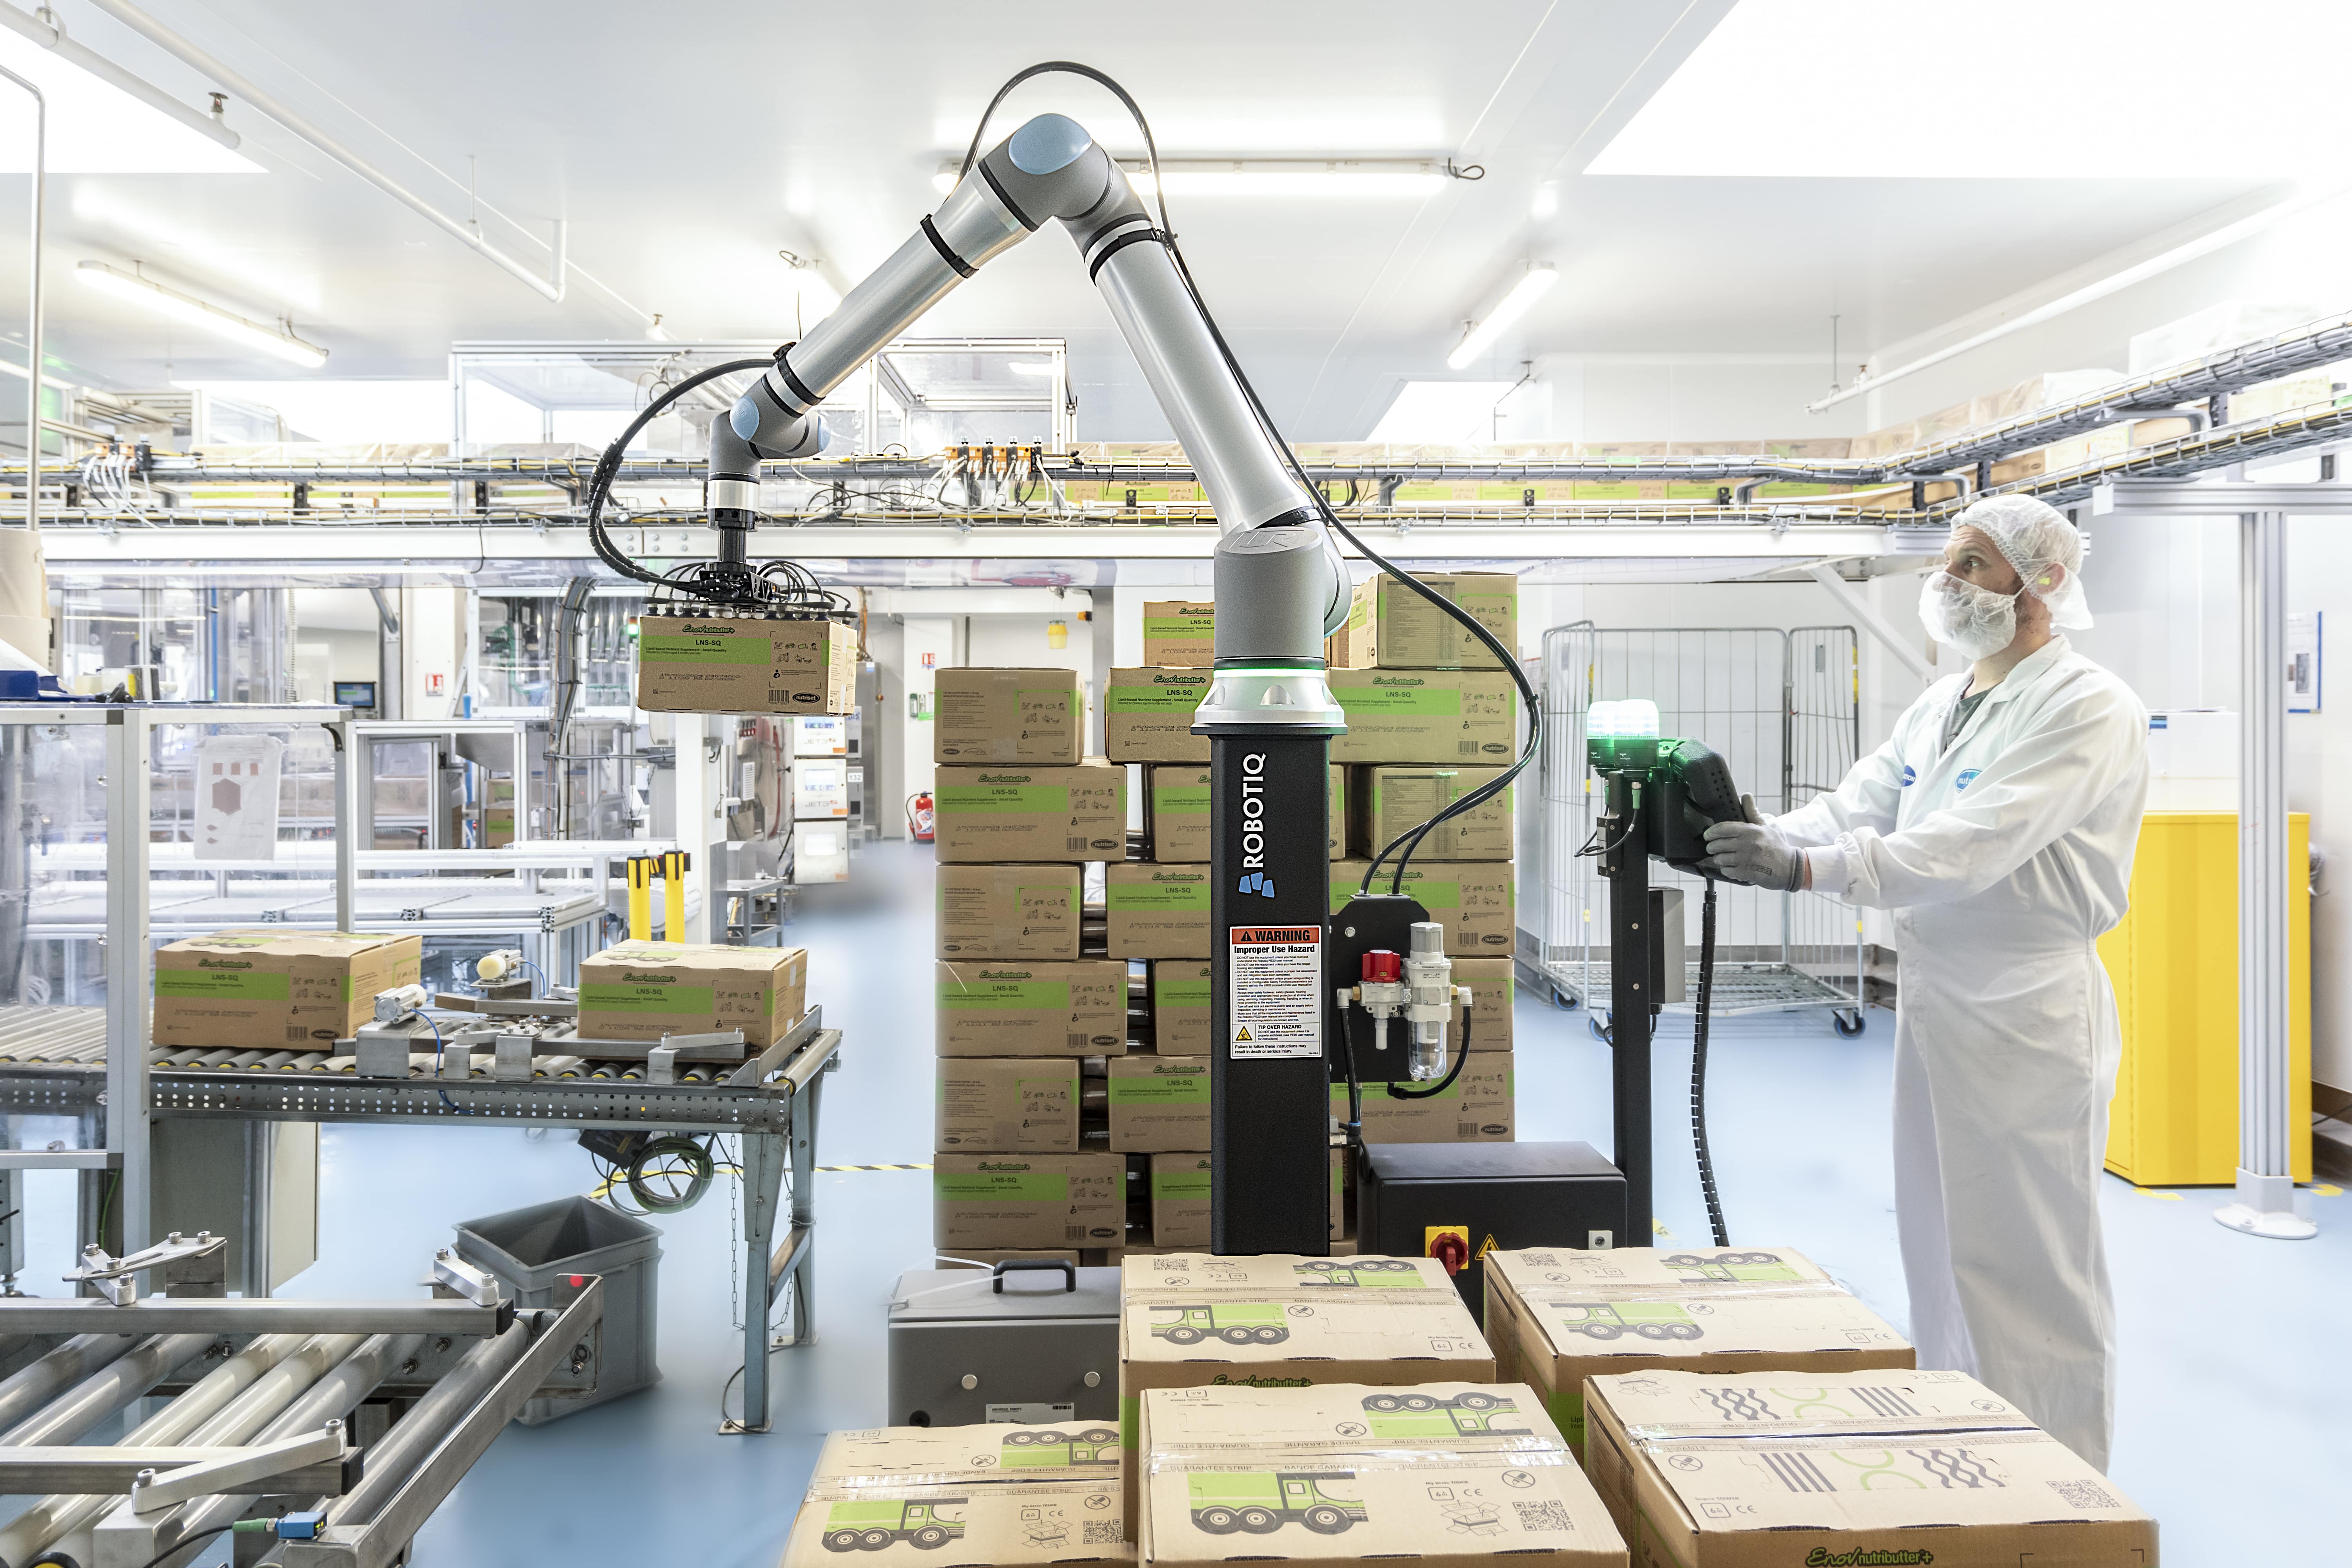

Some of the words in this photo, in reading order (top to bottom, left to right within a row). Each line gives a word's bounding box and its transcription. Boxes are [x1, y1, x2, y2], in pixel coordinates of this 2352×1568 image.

[1243, 753, 1266, 868] ROBOTIQ
[1255, 930, 1310, 941] WARNING
[1234, 946, 1269, 955] Improper
